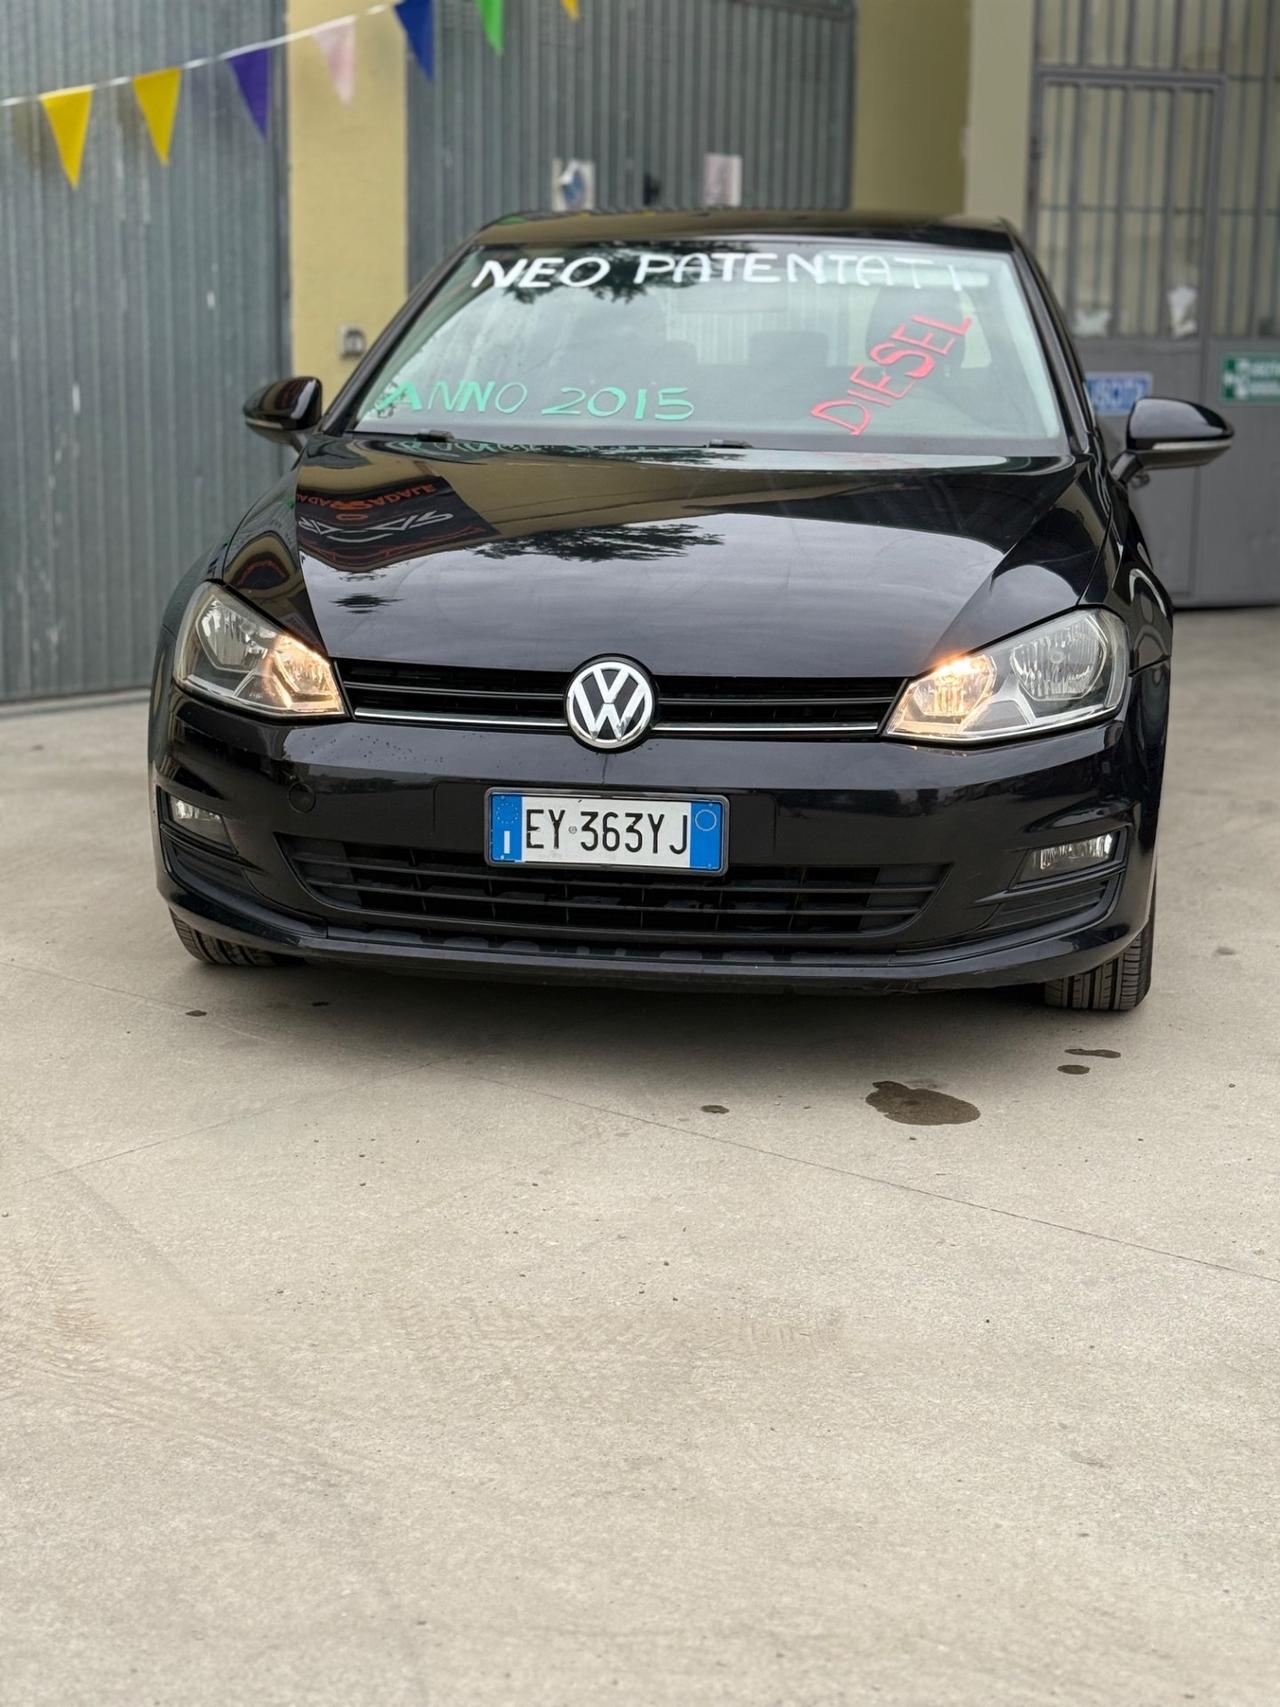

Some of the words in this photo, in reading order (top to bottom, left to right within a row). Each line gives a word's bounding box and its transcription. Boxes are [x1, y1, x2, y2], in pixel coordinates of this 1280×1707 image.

[471, 256, 611, 288] NEO
[632, 252, 962, 291] PATENTATI
[810, 315, 972, 436] DIESEL
[375, 380, 527, 418] ANNO
[541, 386, 695, 421] 2015
